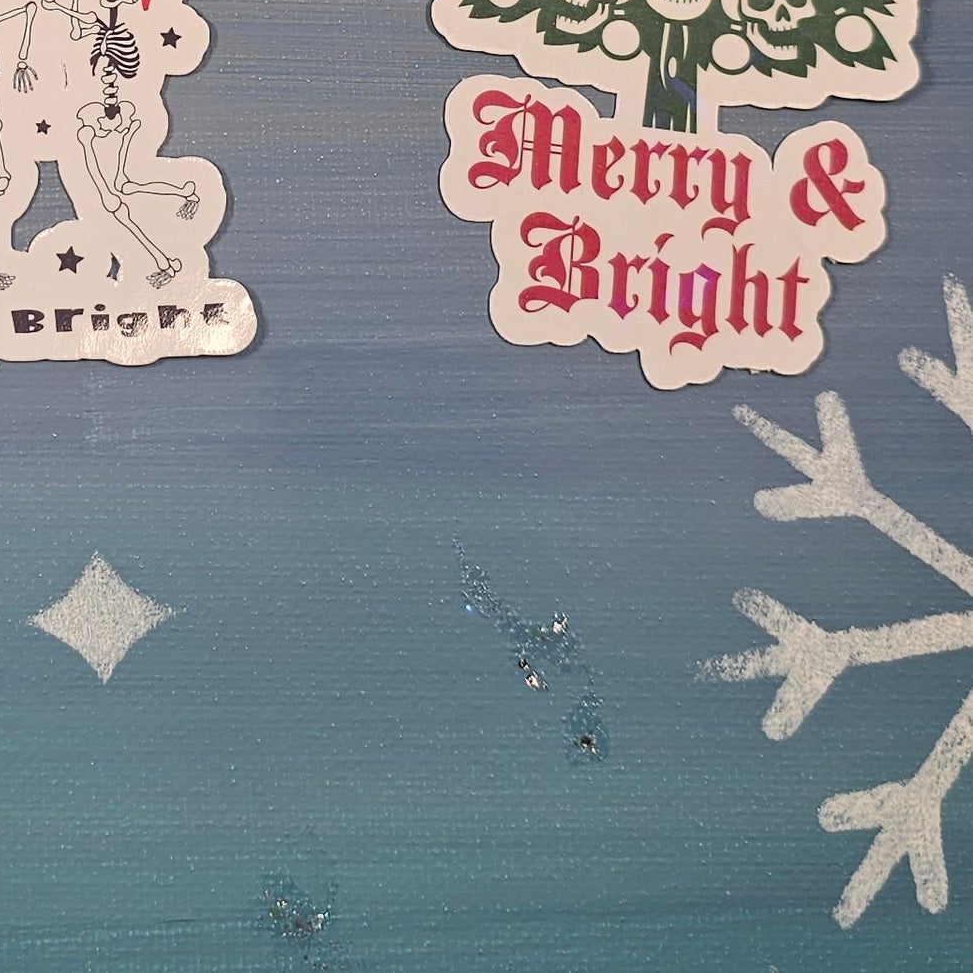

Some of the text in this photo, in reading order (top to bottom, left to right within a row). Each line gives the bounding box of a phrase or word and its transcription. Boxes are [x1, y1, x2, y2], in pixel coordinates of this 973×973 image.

[468, 90, 866, 240] Merry &
[11, 303, 230, 338] Bright
[518, 211, 810, 356] Bright
